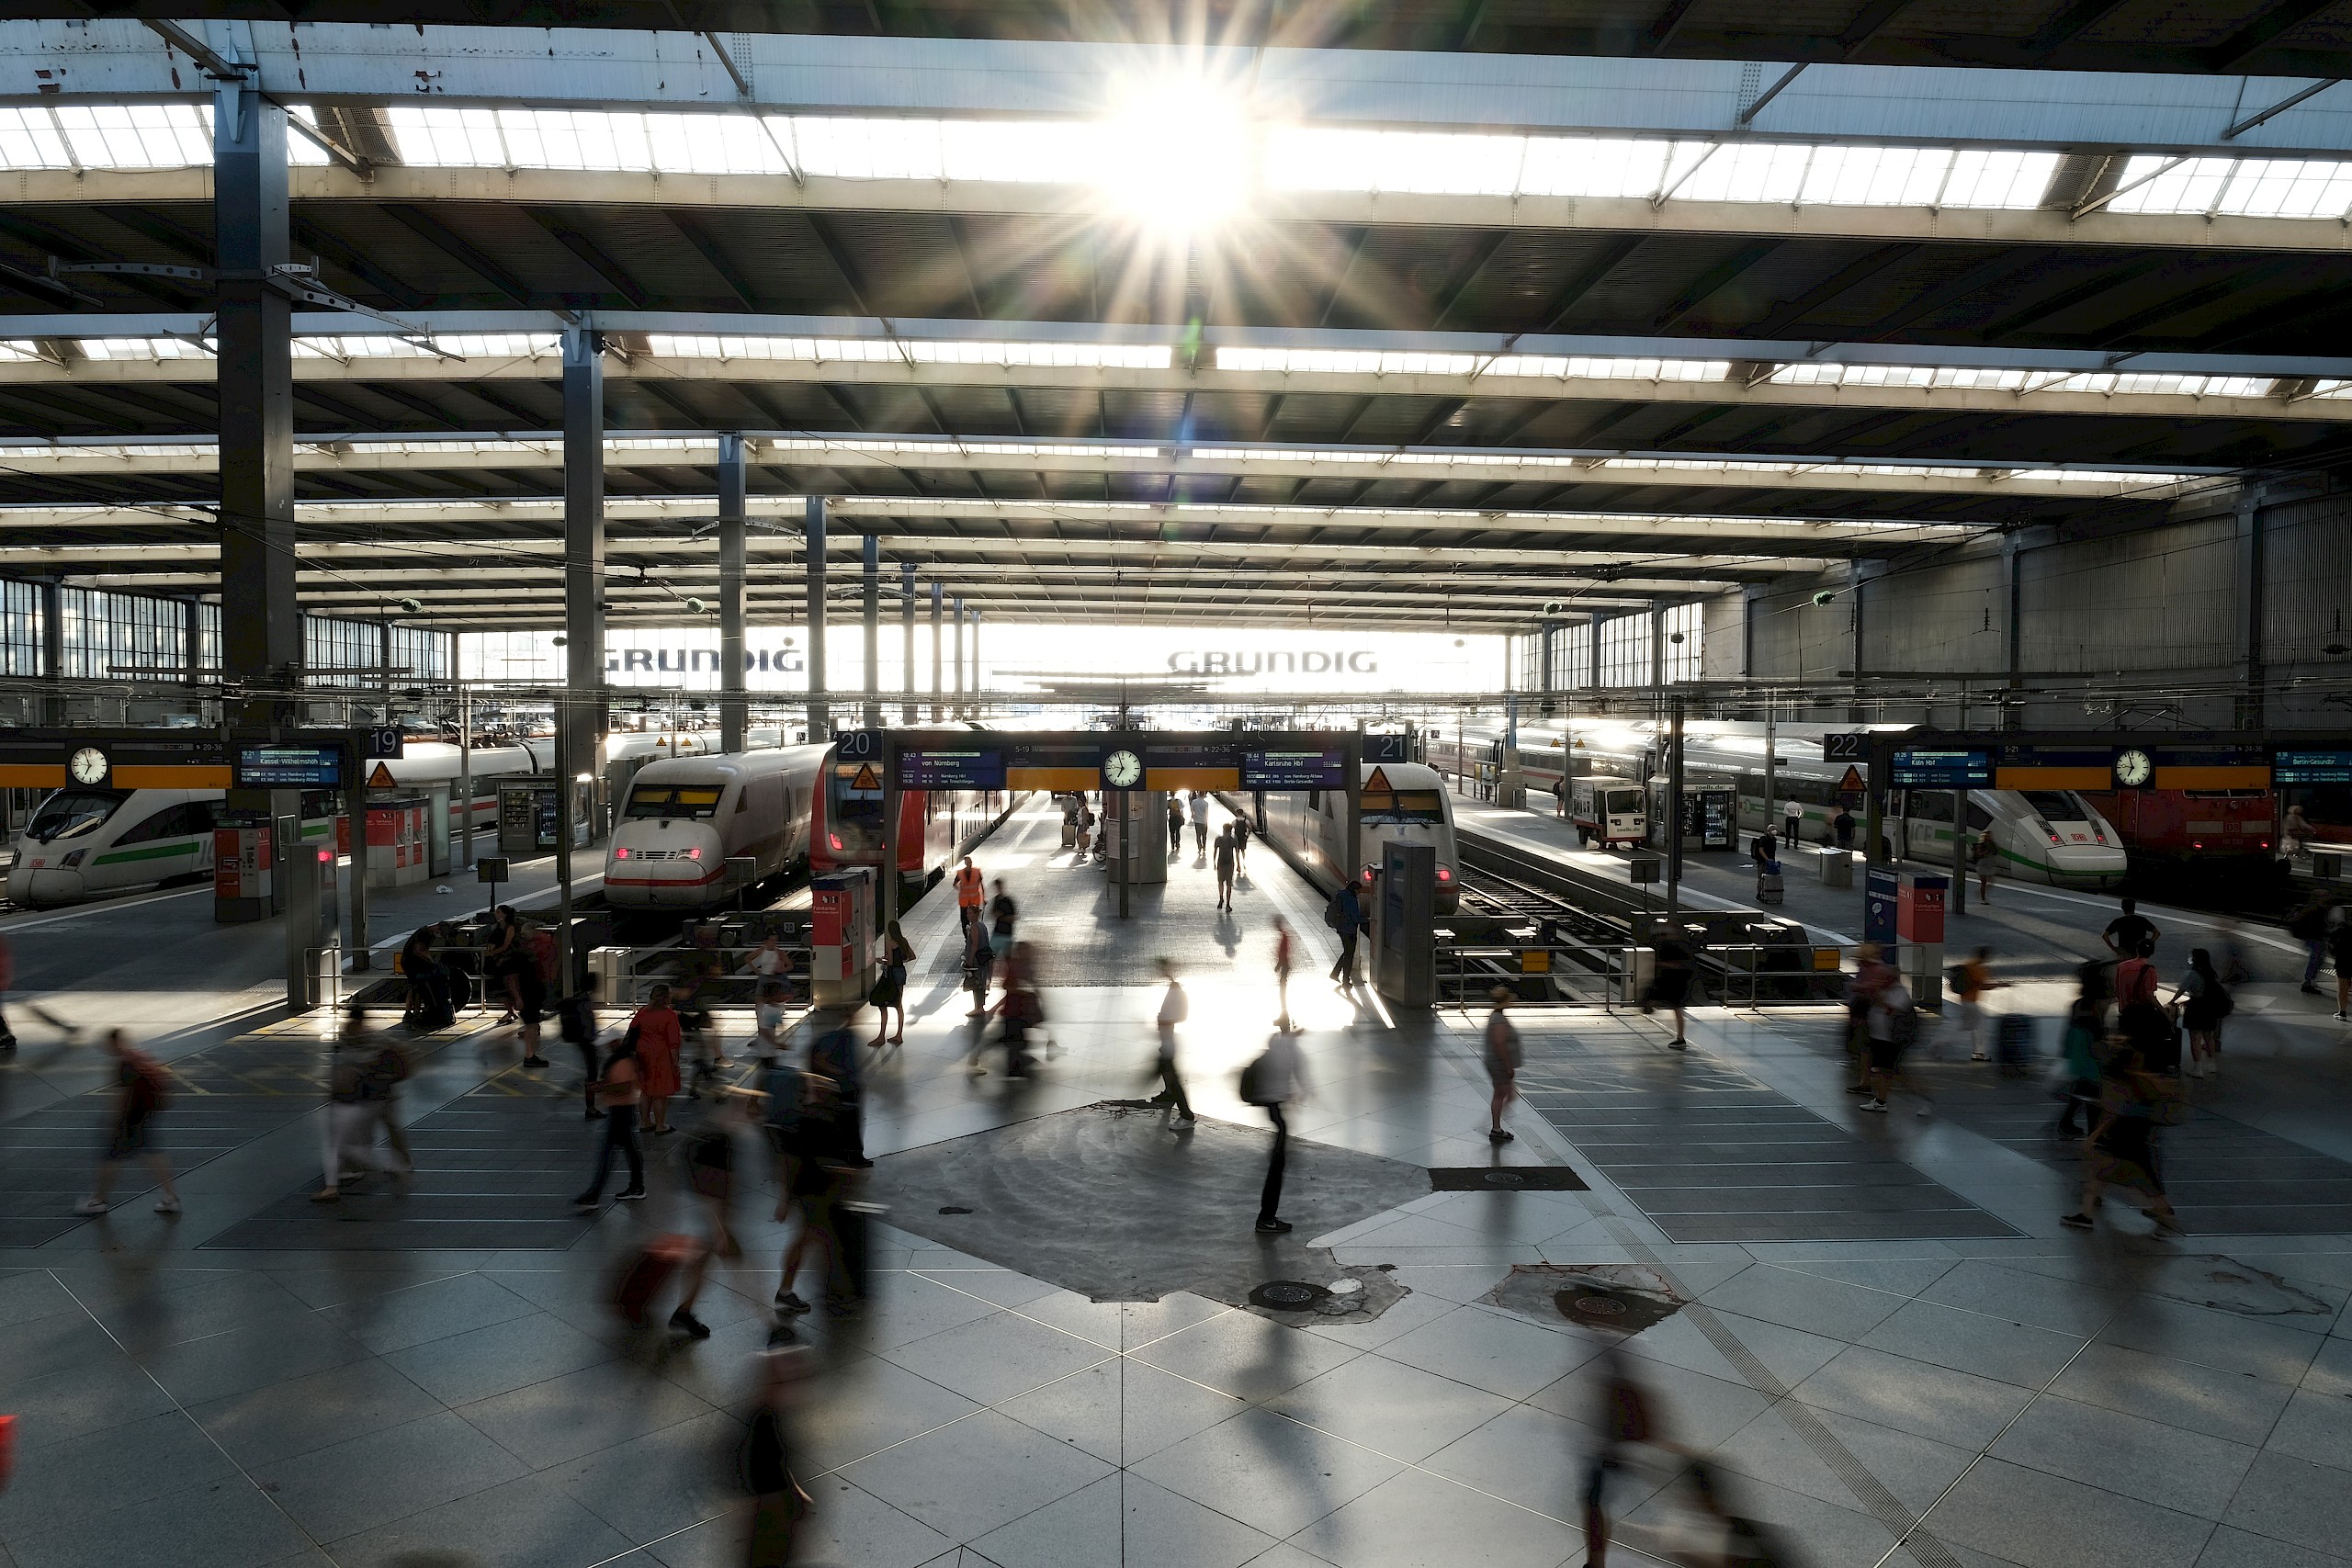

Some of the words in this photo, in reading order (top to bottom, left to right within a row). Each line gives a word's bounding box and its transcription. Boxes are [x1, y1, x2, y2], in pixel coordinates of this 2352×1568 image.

[1167, 650, 1377, 673] GRUNDIG
[202, 743, 223, 751] 20-36
[370, 730, 397, 753] 19
[841, 732, 871, 755] 20
[1014, 745, 1030, 753] 5-19
[1380, 735, 1403, 758] 21
[1830, 734, 1858, 757] 22
[2004, 745, 2018, 753] 5-21
[2226, 823, 2240, 831] DB
[31, 859, 44, 867] DB
